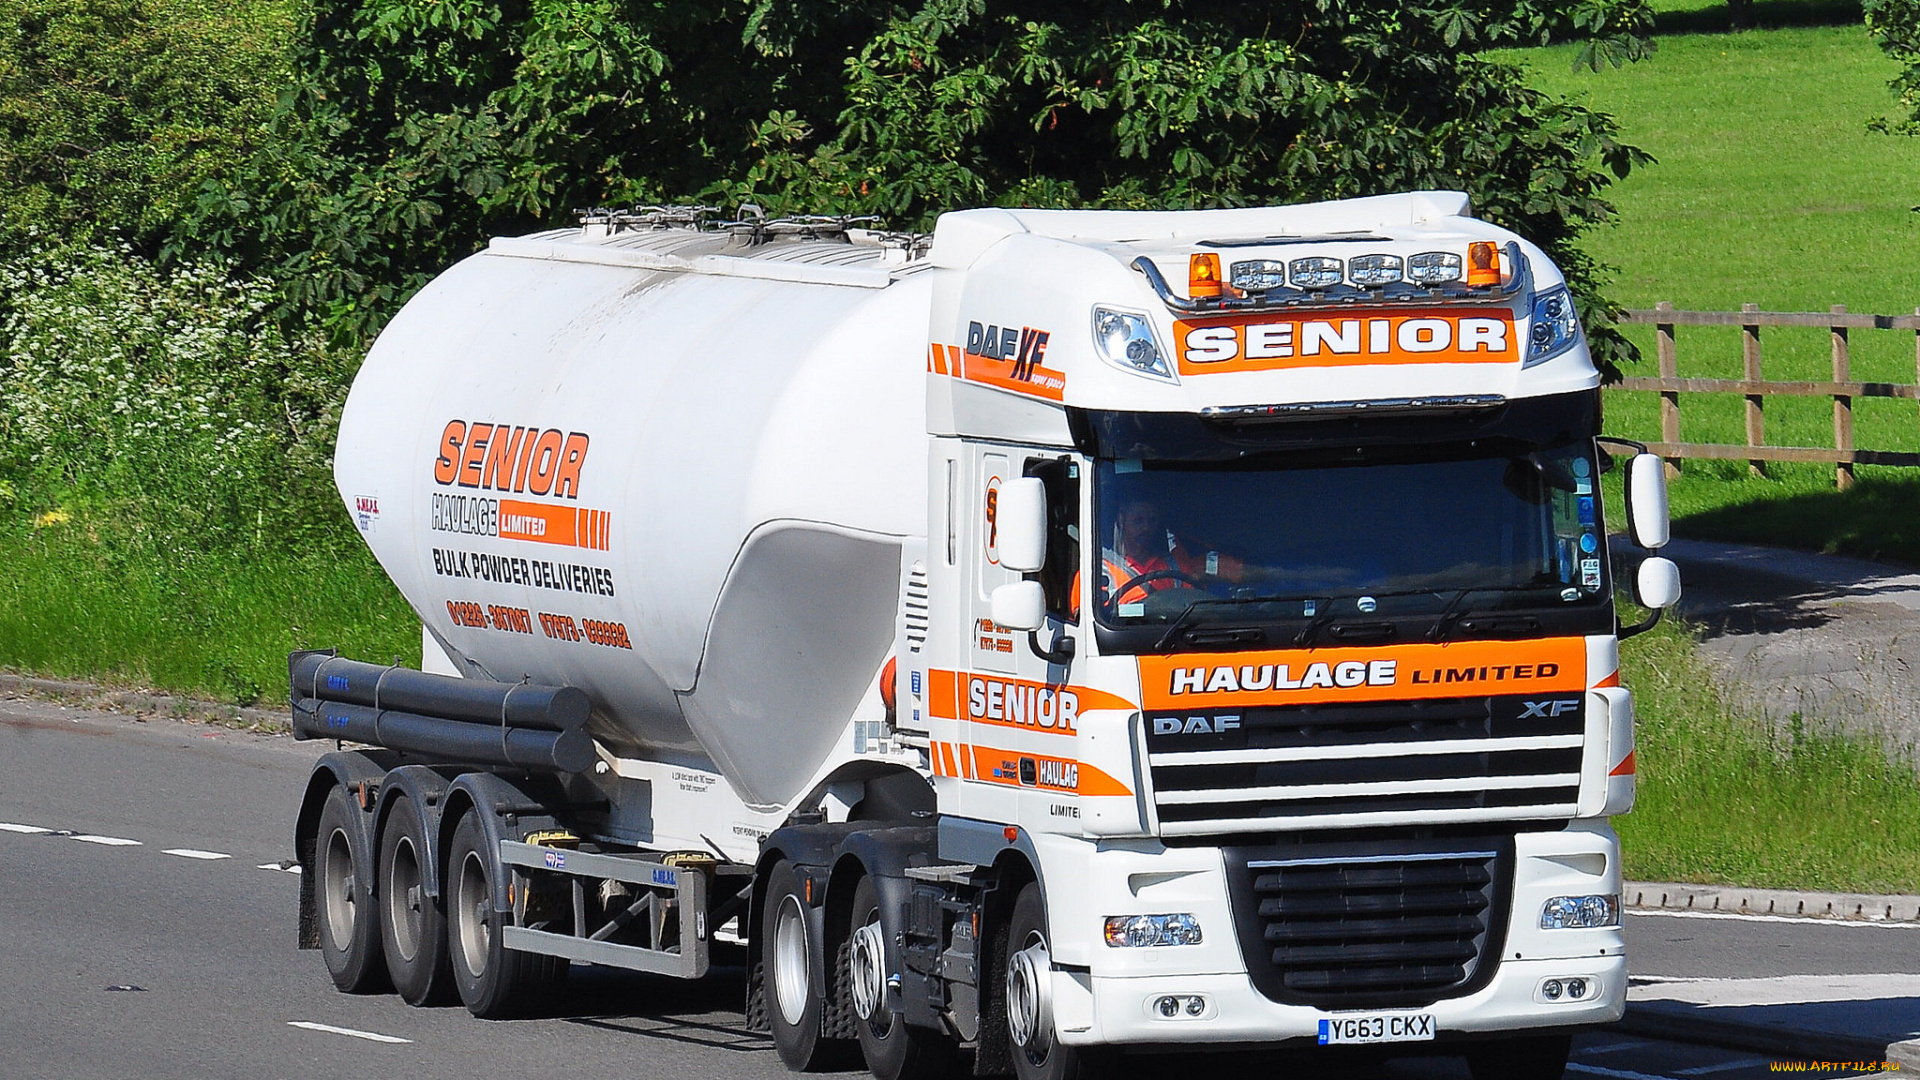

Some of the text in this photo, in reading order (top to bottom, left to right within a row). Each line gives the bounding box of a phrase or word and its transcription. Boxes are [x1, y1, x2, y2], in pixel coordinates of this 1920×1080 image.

[966, 320, 1050, 382] DAF XF
[1184, 317, 1507, 364] SENIOR
[433, 419, 590, 499] SENIOR
[432, 493, 546, 536] HAULAGE LIMITED
[432, 548, 614, 597] BULK POWDER DELIVERIES
[1170, 660, 1559, 695] HAULAGE LIMITED
[969, 678, 1079, 730] SENIOR
[1516, 699, 1580, 719] XF
[1153, 715, 1241, 735] DAF
[1039, 759, 1079, 789] HAULAG
[1050, 803, 1080, 819] LIMITE
[1332, 1015, 1430, 1039] YG63 CKX
